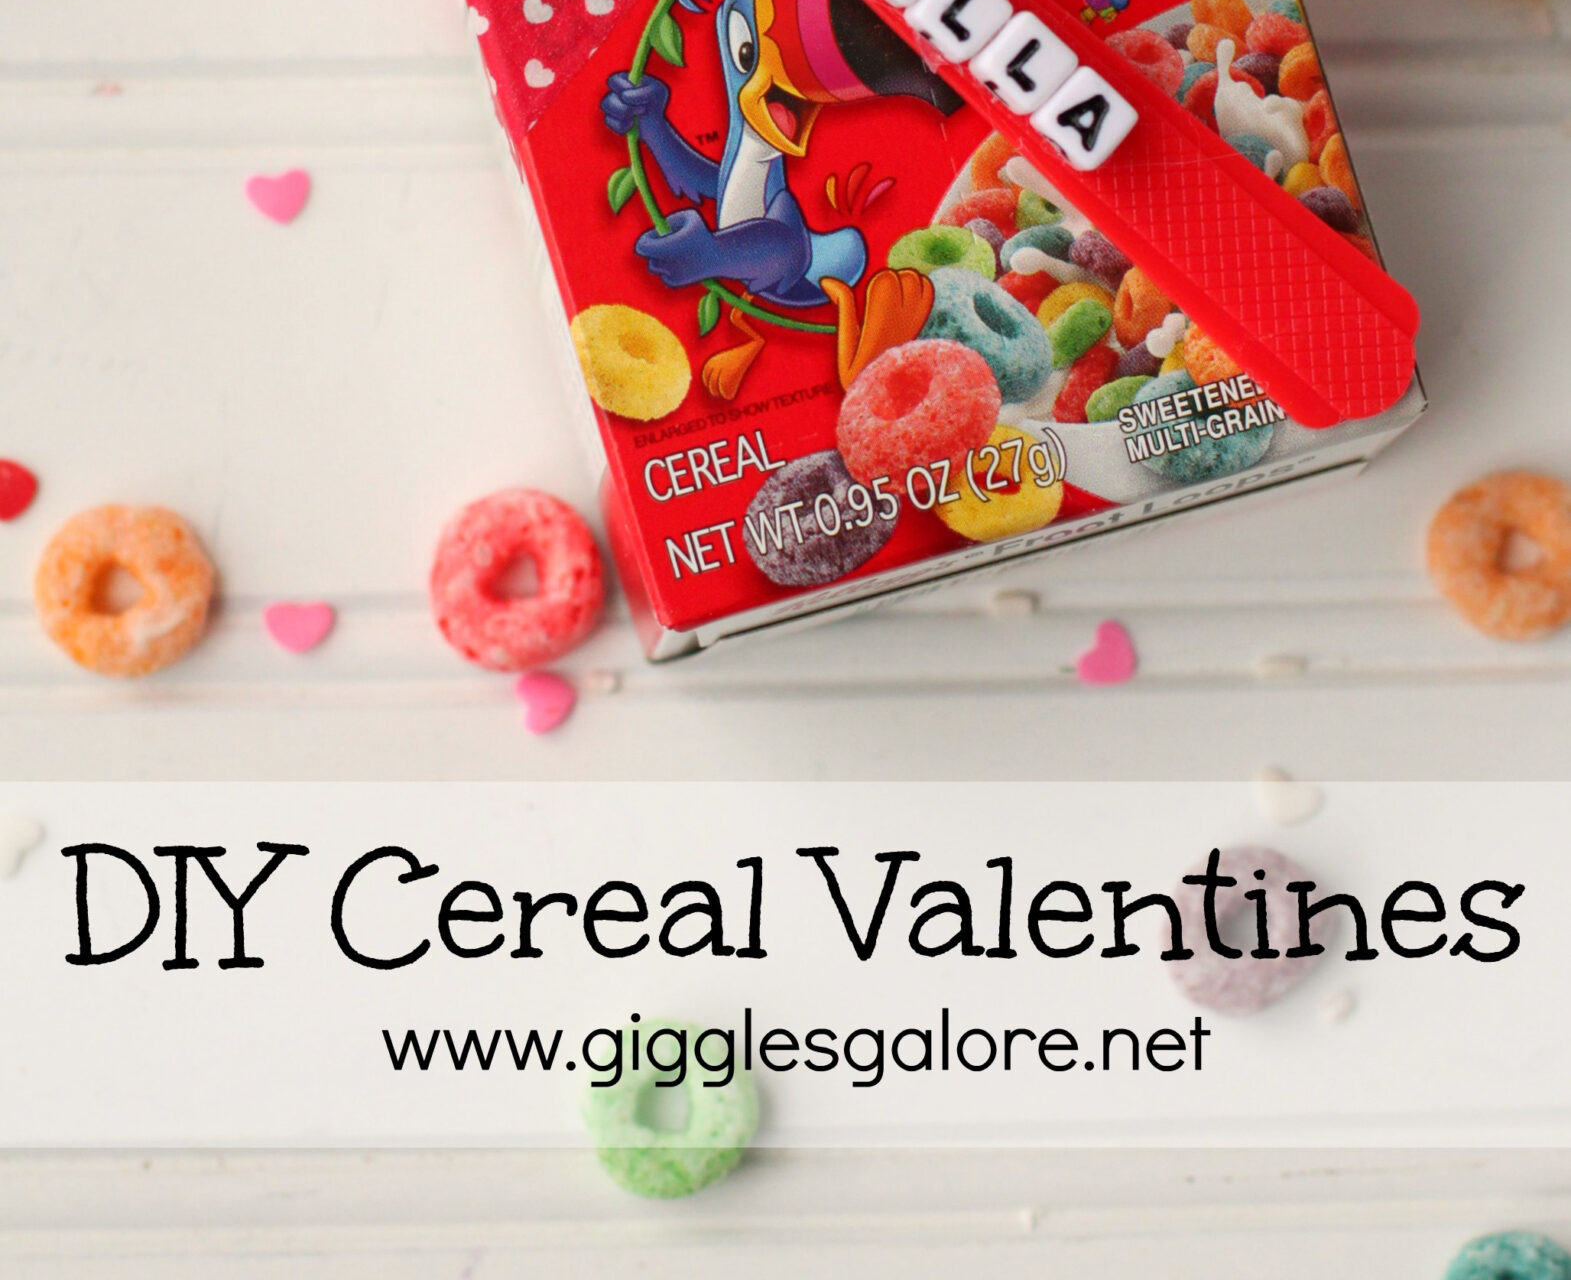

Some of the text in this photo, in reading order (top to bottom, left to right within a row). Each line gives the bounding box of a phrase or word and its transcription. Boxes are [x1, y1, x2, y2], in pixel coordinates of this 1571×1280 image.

[634, 382, 835, 449] ENLARGED TO SHOW TEXTURE
[1124, 397, 1287, 464] MULTI-GRAIN
[643, 429, 787, 503] CEREAL
[663, 426, 1068, 580] NET WT 0.95 OZ (27g)
[993, 511, 1124, 557] Froot
[1142, 463, 1297, 514] Loops
